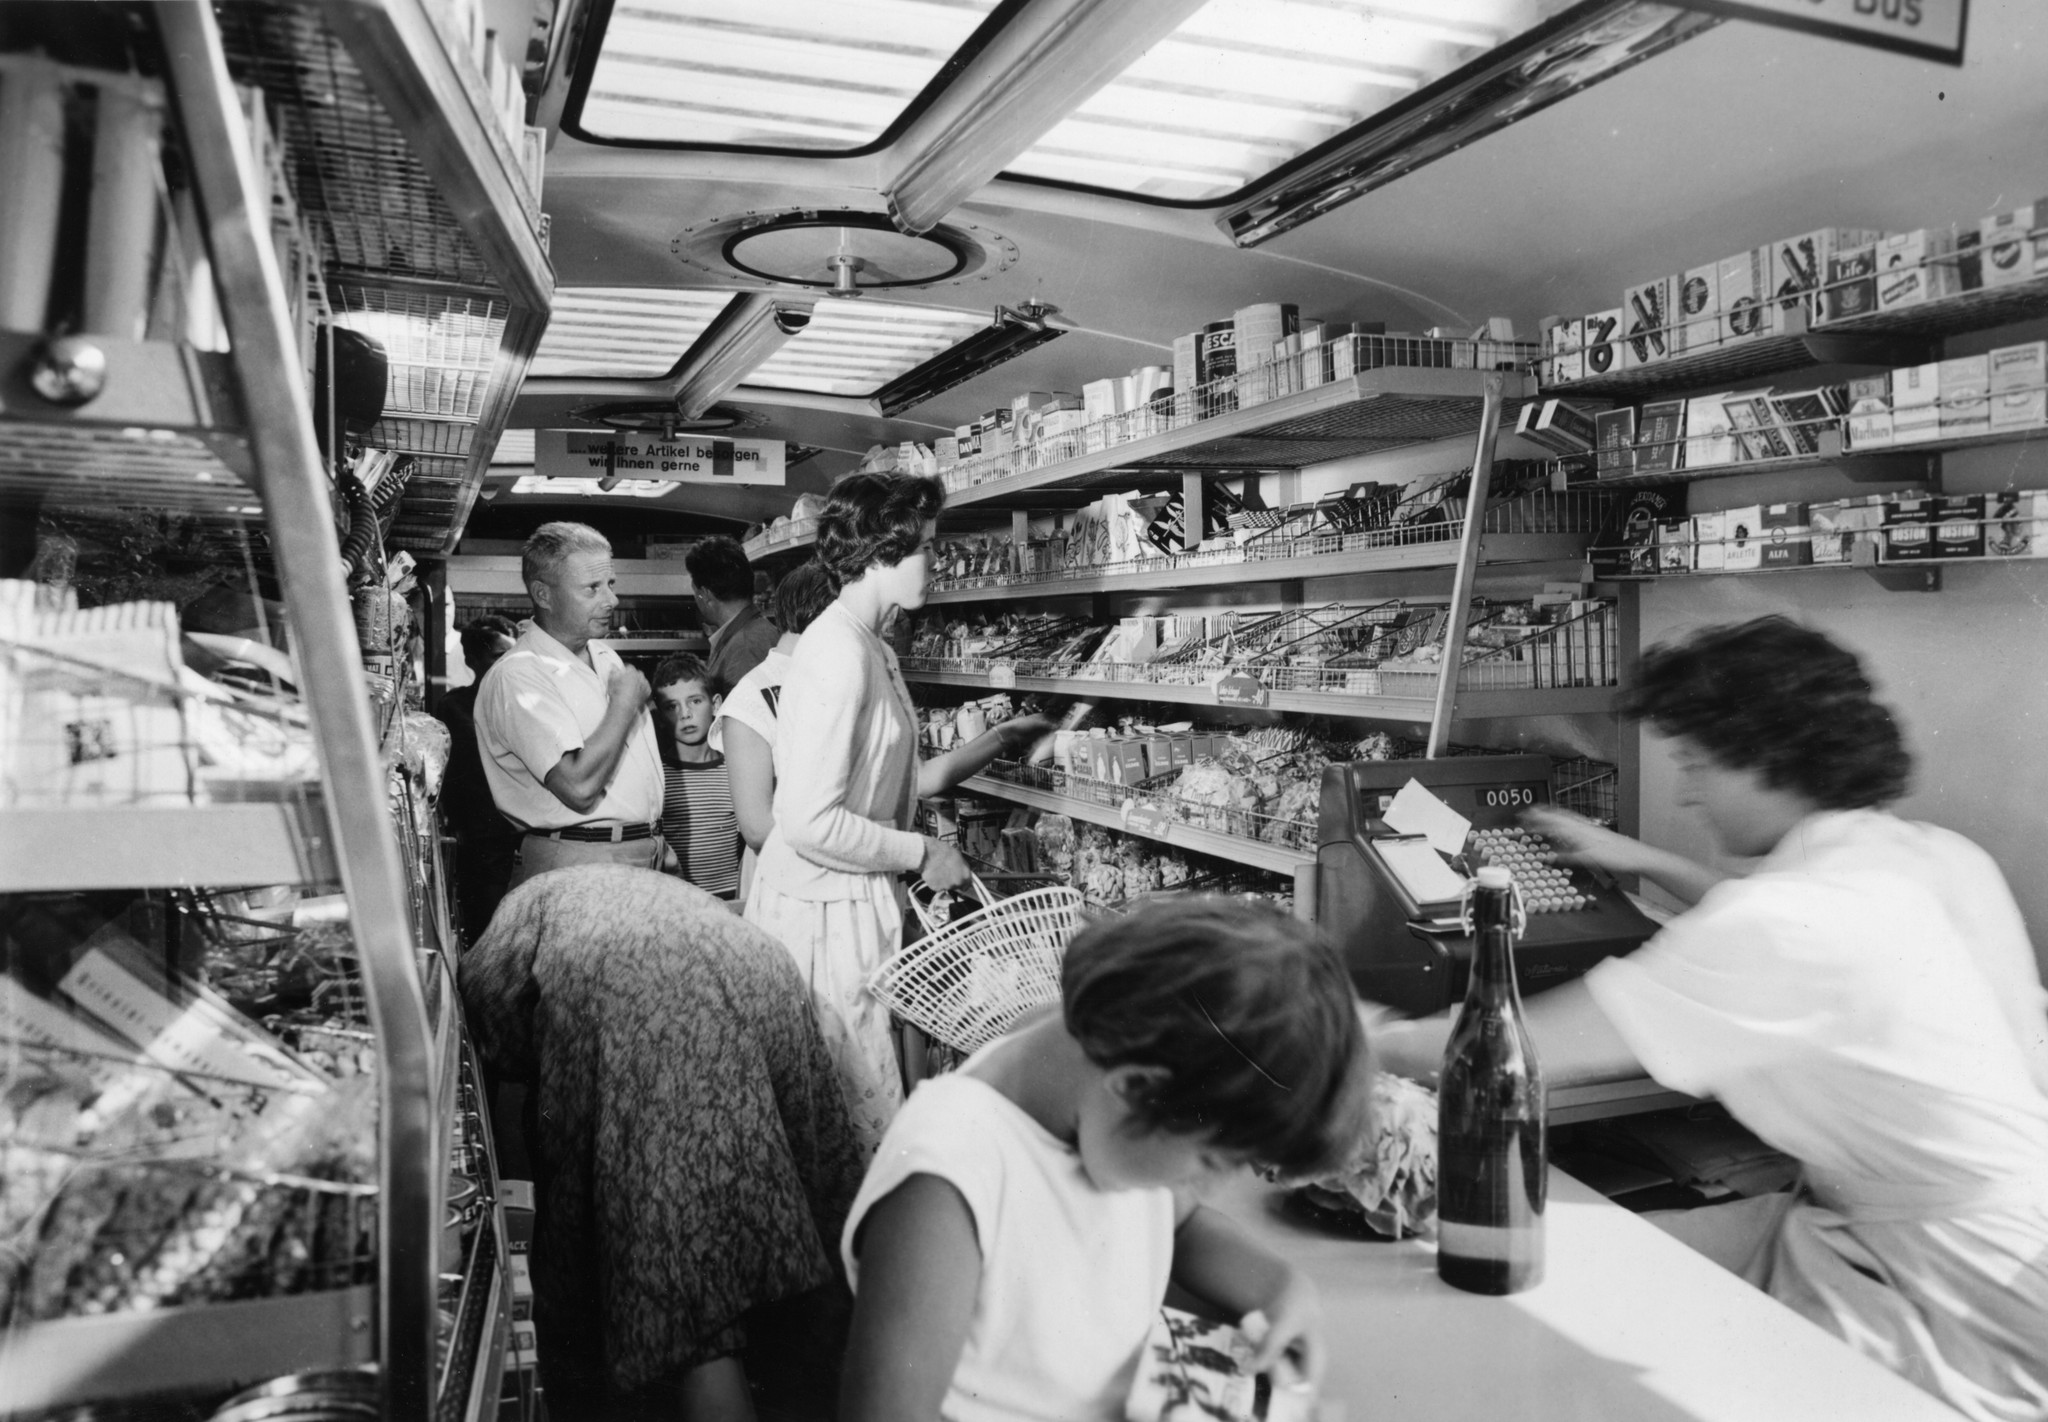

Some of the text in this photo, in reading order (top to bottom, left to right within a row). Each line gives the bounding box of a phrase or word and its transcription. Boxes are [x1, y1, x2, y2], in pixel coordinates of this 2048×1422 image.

[1836, 261, 1864, 281] Life
[645, 444, 690, 458] Artikel
[616, 455, 654, 470] Ihnen
[661, 460, 700, 472] gerne
[1768, 549, 1789, 560] ALFA
[1486, 788, 1533, 807] 0050
